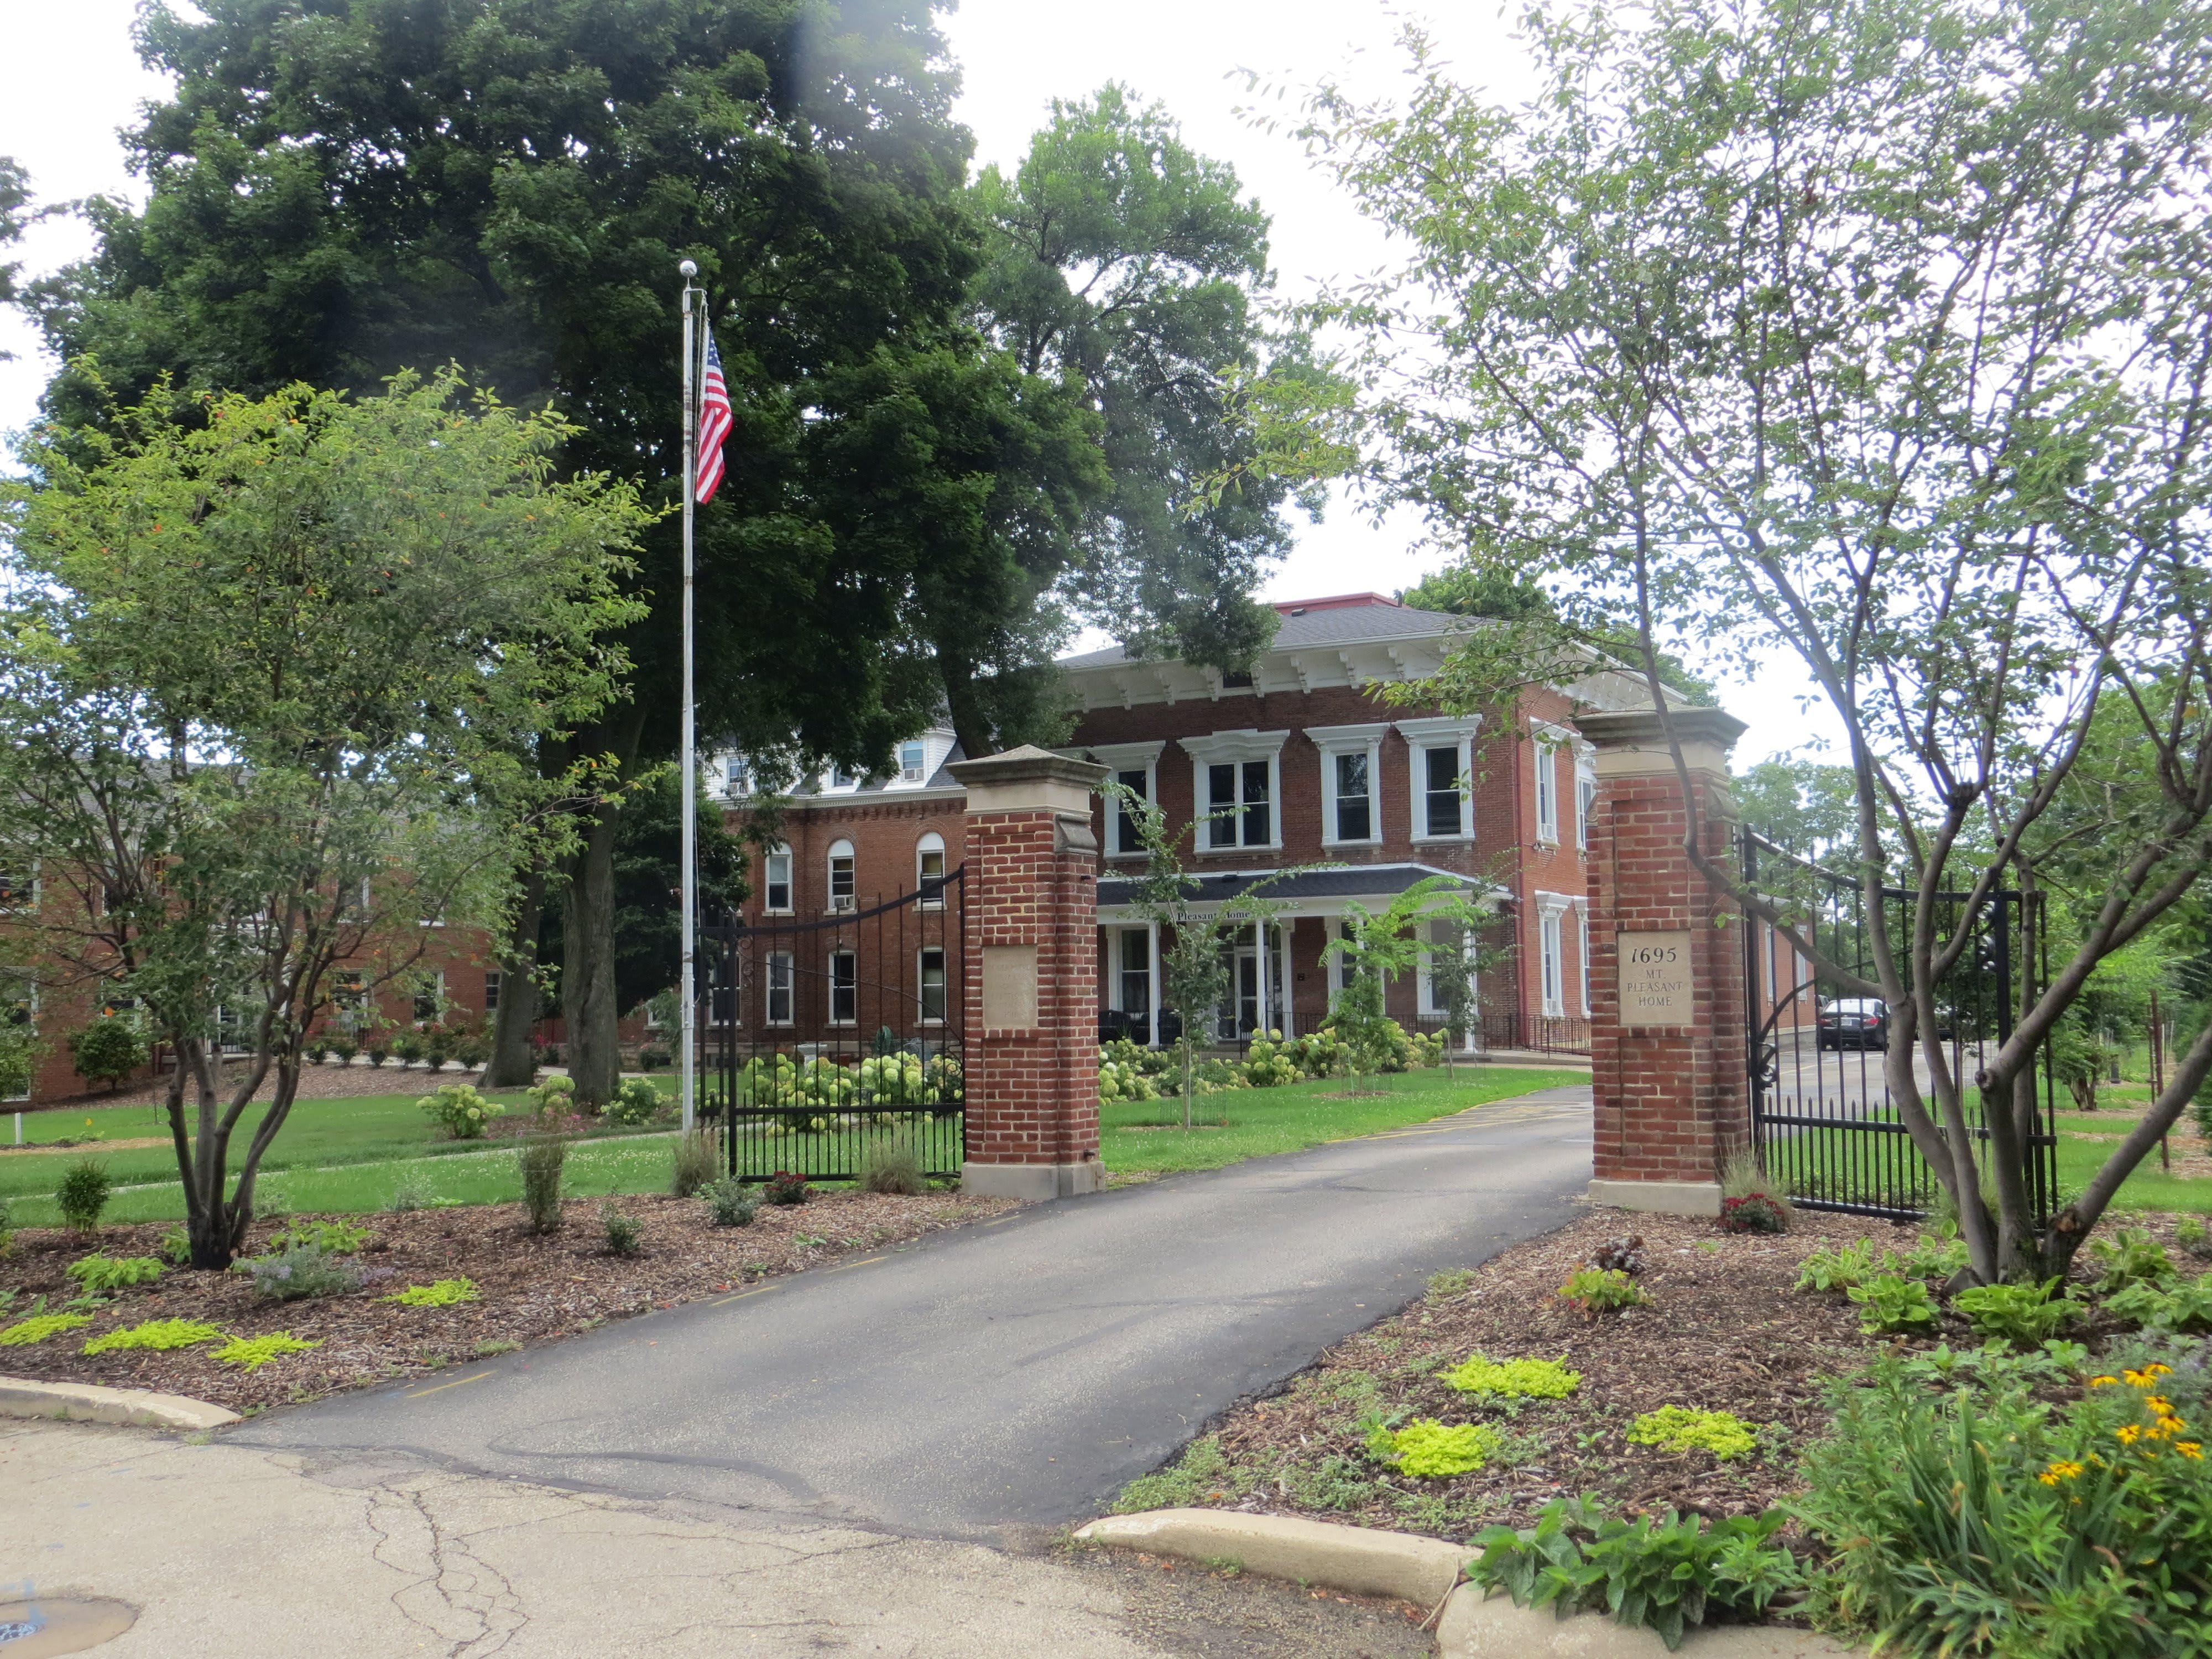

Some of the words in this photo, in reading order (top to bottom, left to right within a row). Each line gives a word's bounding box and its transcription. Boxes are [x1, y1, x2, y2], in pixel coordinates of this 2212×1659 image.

[1631, 947, 1677, 963] 1695
[1646, 969, 1666, 979] MT.
[1627, 982, 1682, 992] PLEASANT
[1639, 997, 1672, 1006] HOME
